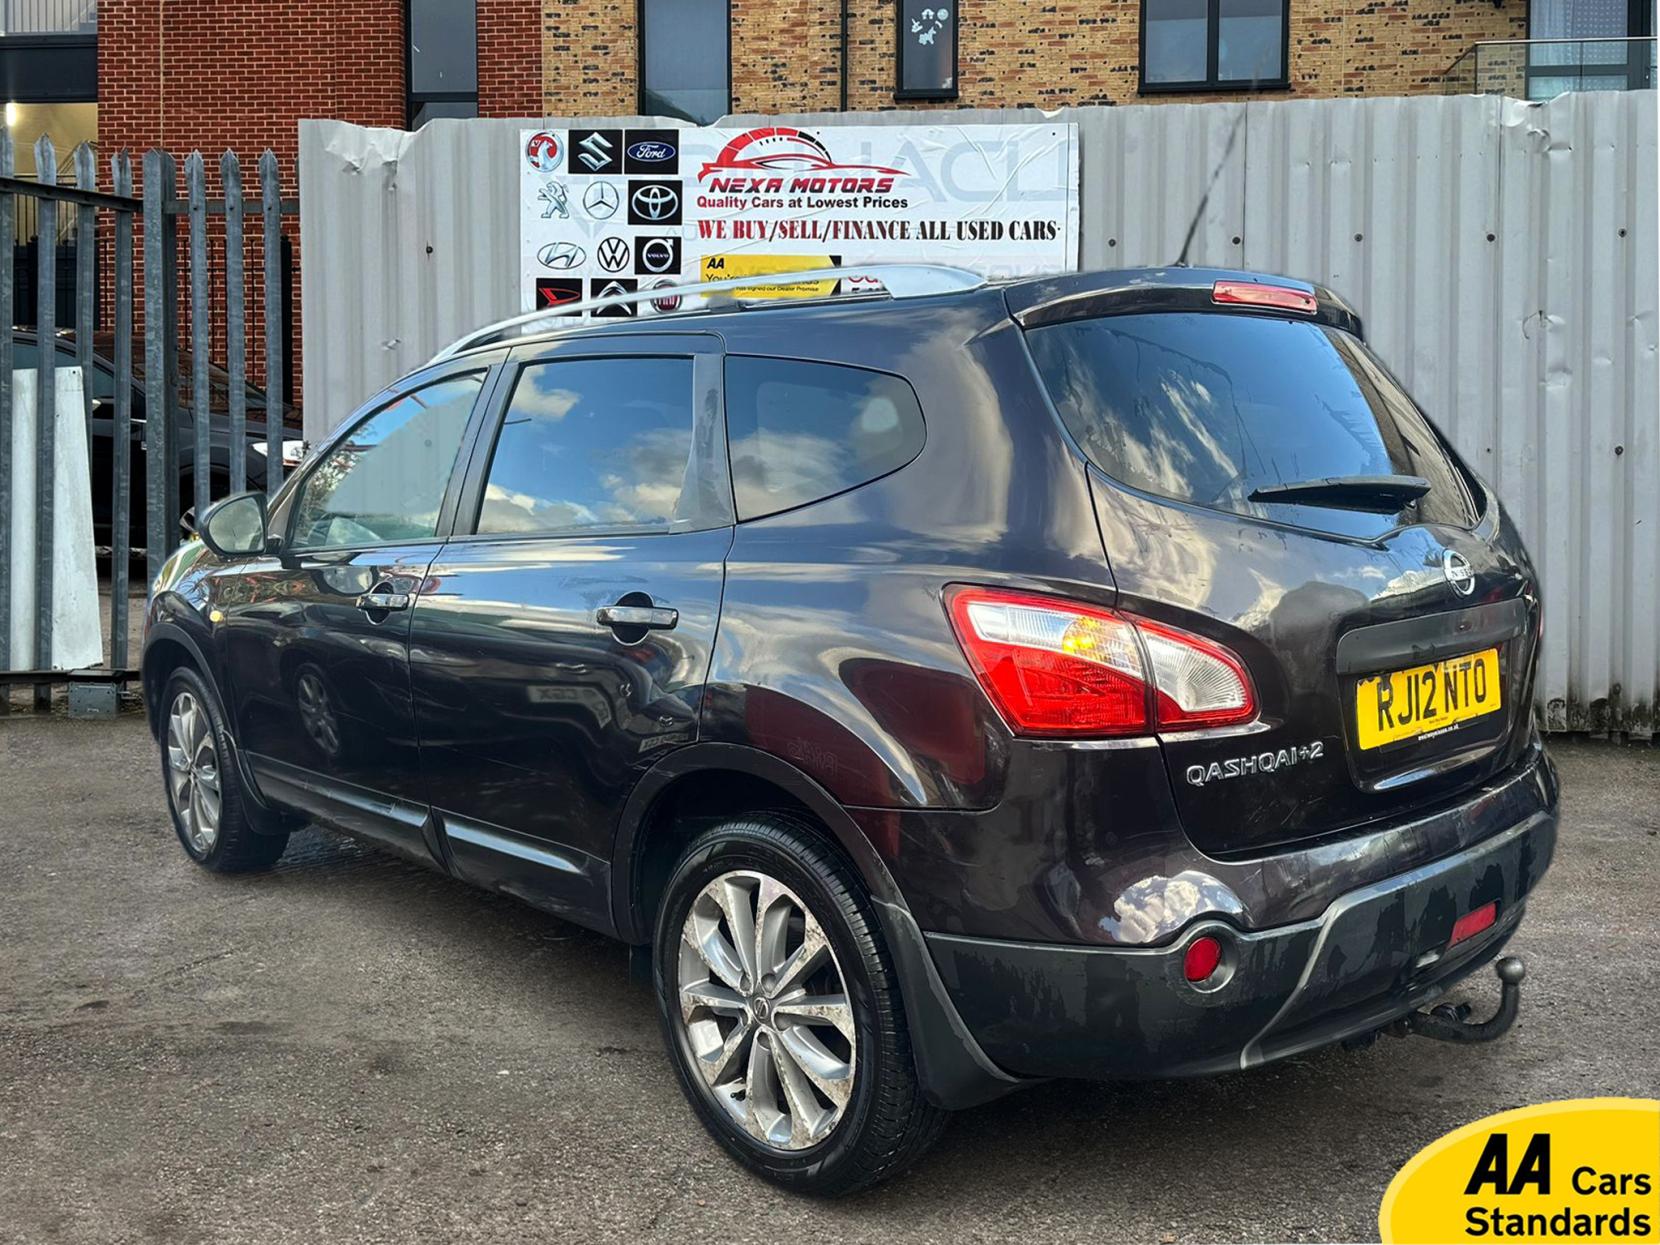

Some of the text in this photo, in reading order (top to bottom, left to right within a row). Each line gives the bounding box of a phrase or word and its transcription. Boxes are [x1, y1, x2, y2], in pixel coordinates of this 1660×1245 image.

[636, 143, 667, 158] Ford
[709, 178, 894, 194] NEXA MOTORS
[697, 196, 909, 210] Quality Cars at Lowest Prices
[697, 219, 727, 240] WE
[732, 219, 911, 243] BUY/SELL/FINANCE
[916, 220, 951, 241] ALL
[956, 220, 1004, 241] USED
[1008, 220, 1057, 241] CARS
[706, 257, 725, 269] AA
[1444, 657, 1487, 714] NTO
